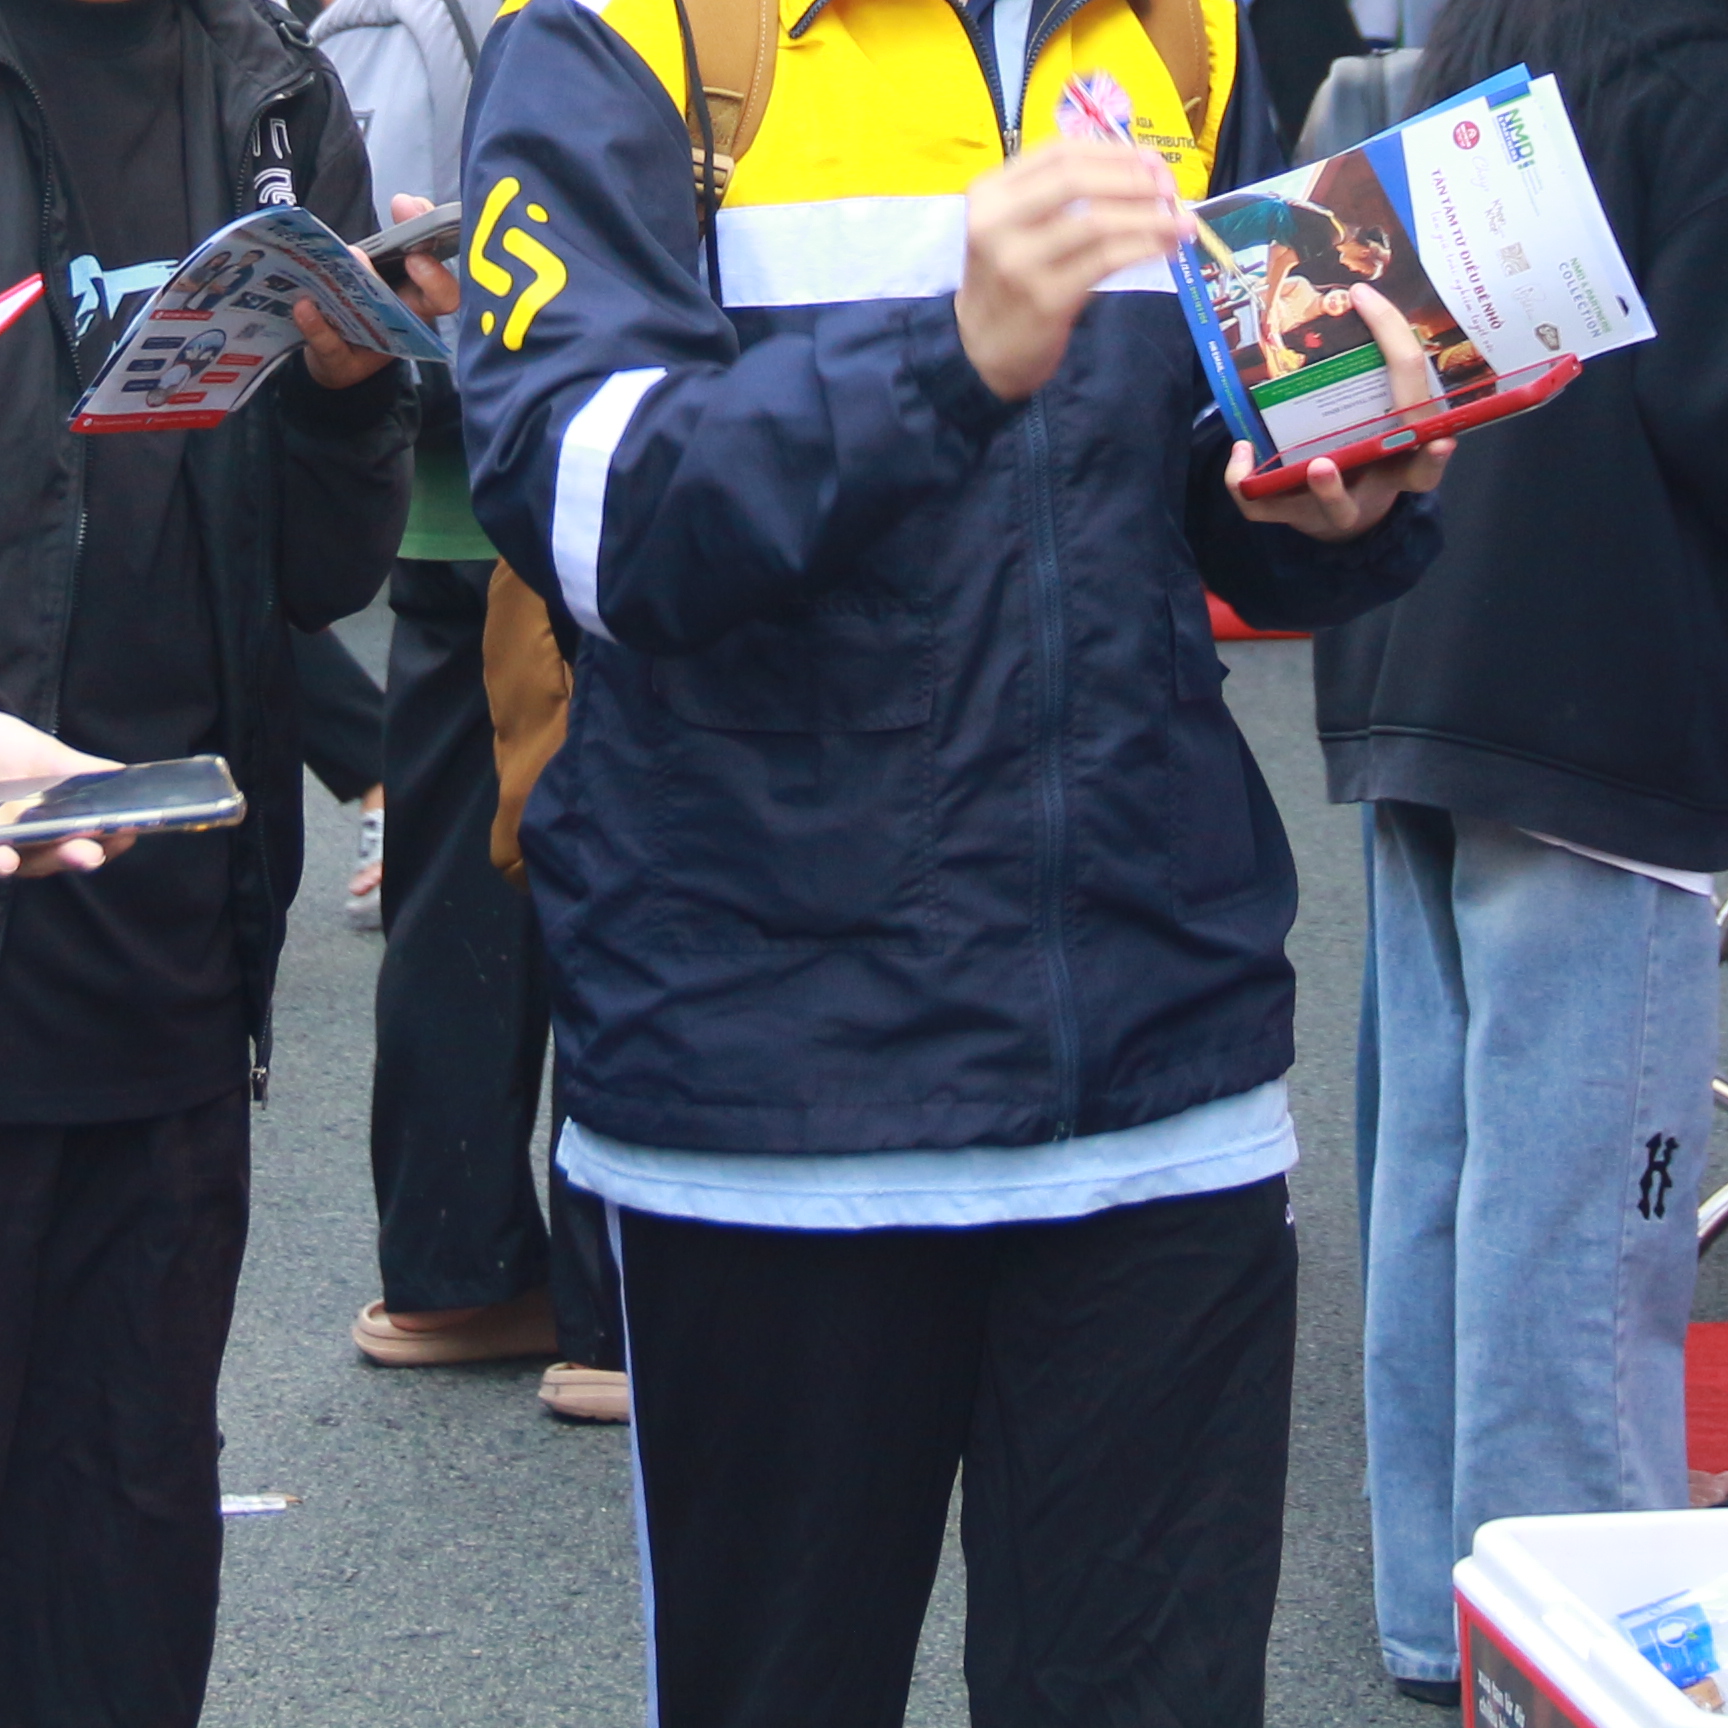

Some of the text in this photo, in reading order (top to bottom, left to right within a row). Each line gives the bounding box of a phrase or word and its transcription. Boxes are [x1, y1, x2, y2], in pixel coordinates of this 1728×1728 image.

[1136, 132, 1198, 150] DISTRIBUTIO
[1441, 197, 1459, 227] TÂM
[1558, 261, 1603, 339] COLLECTION
